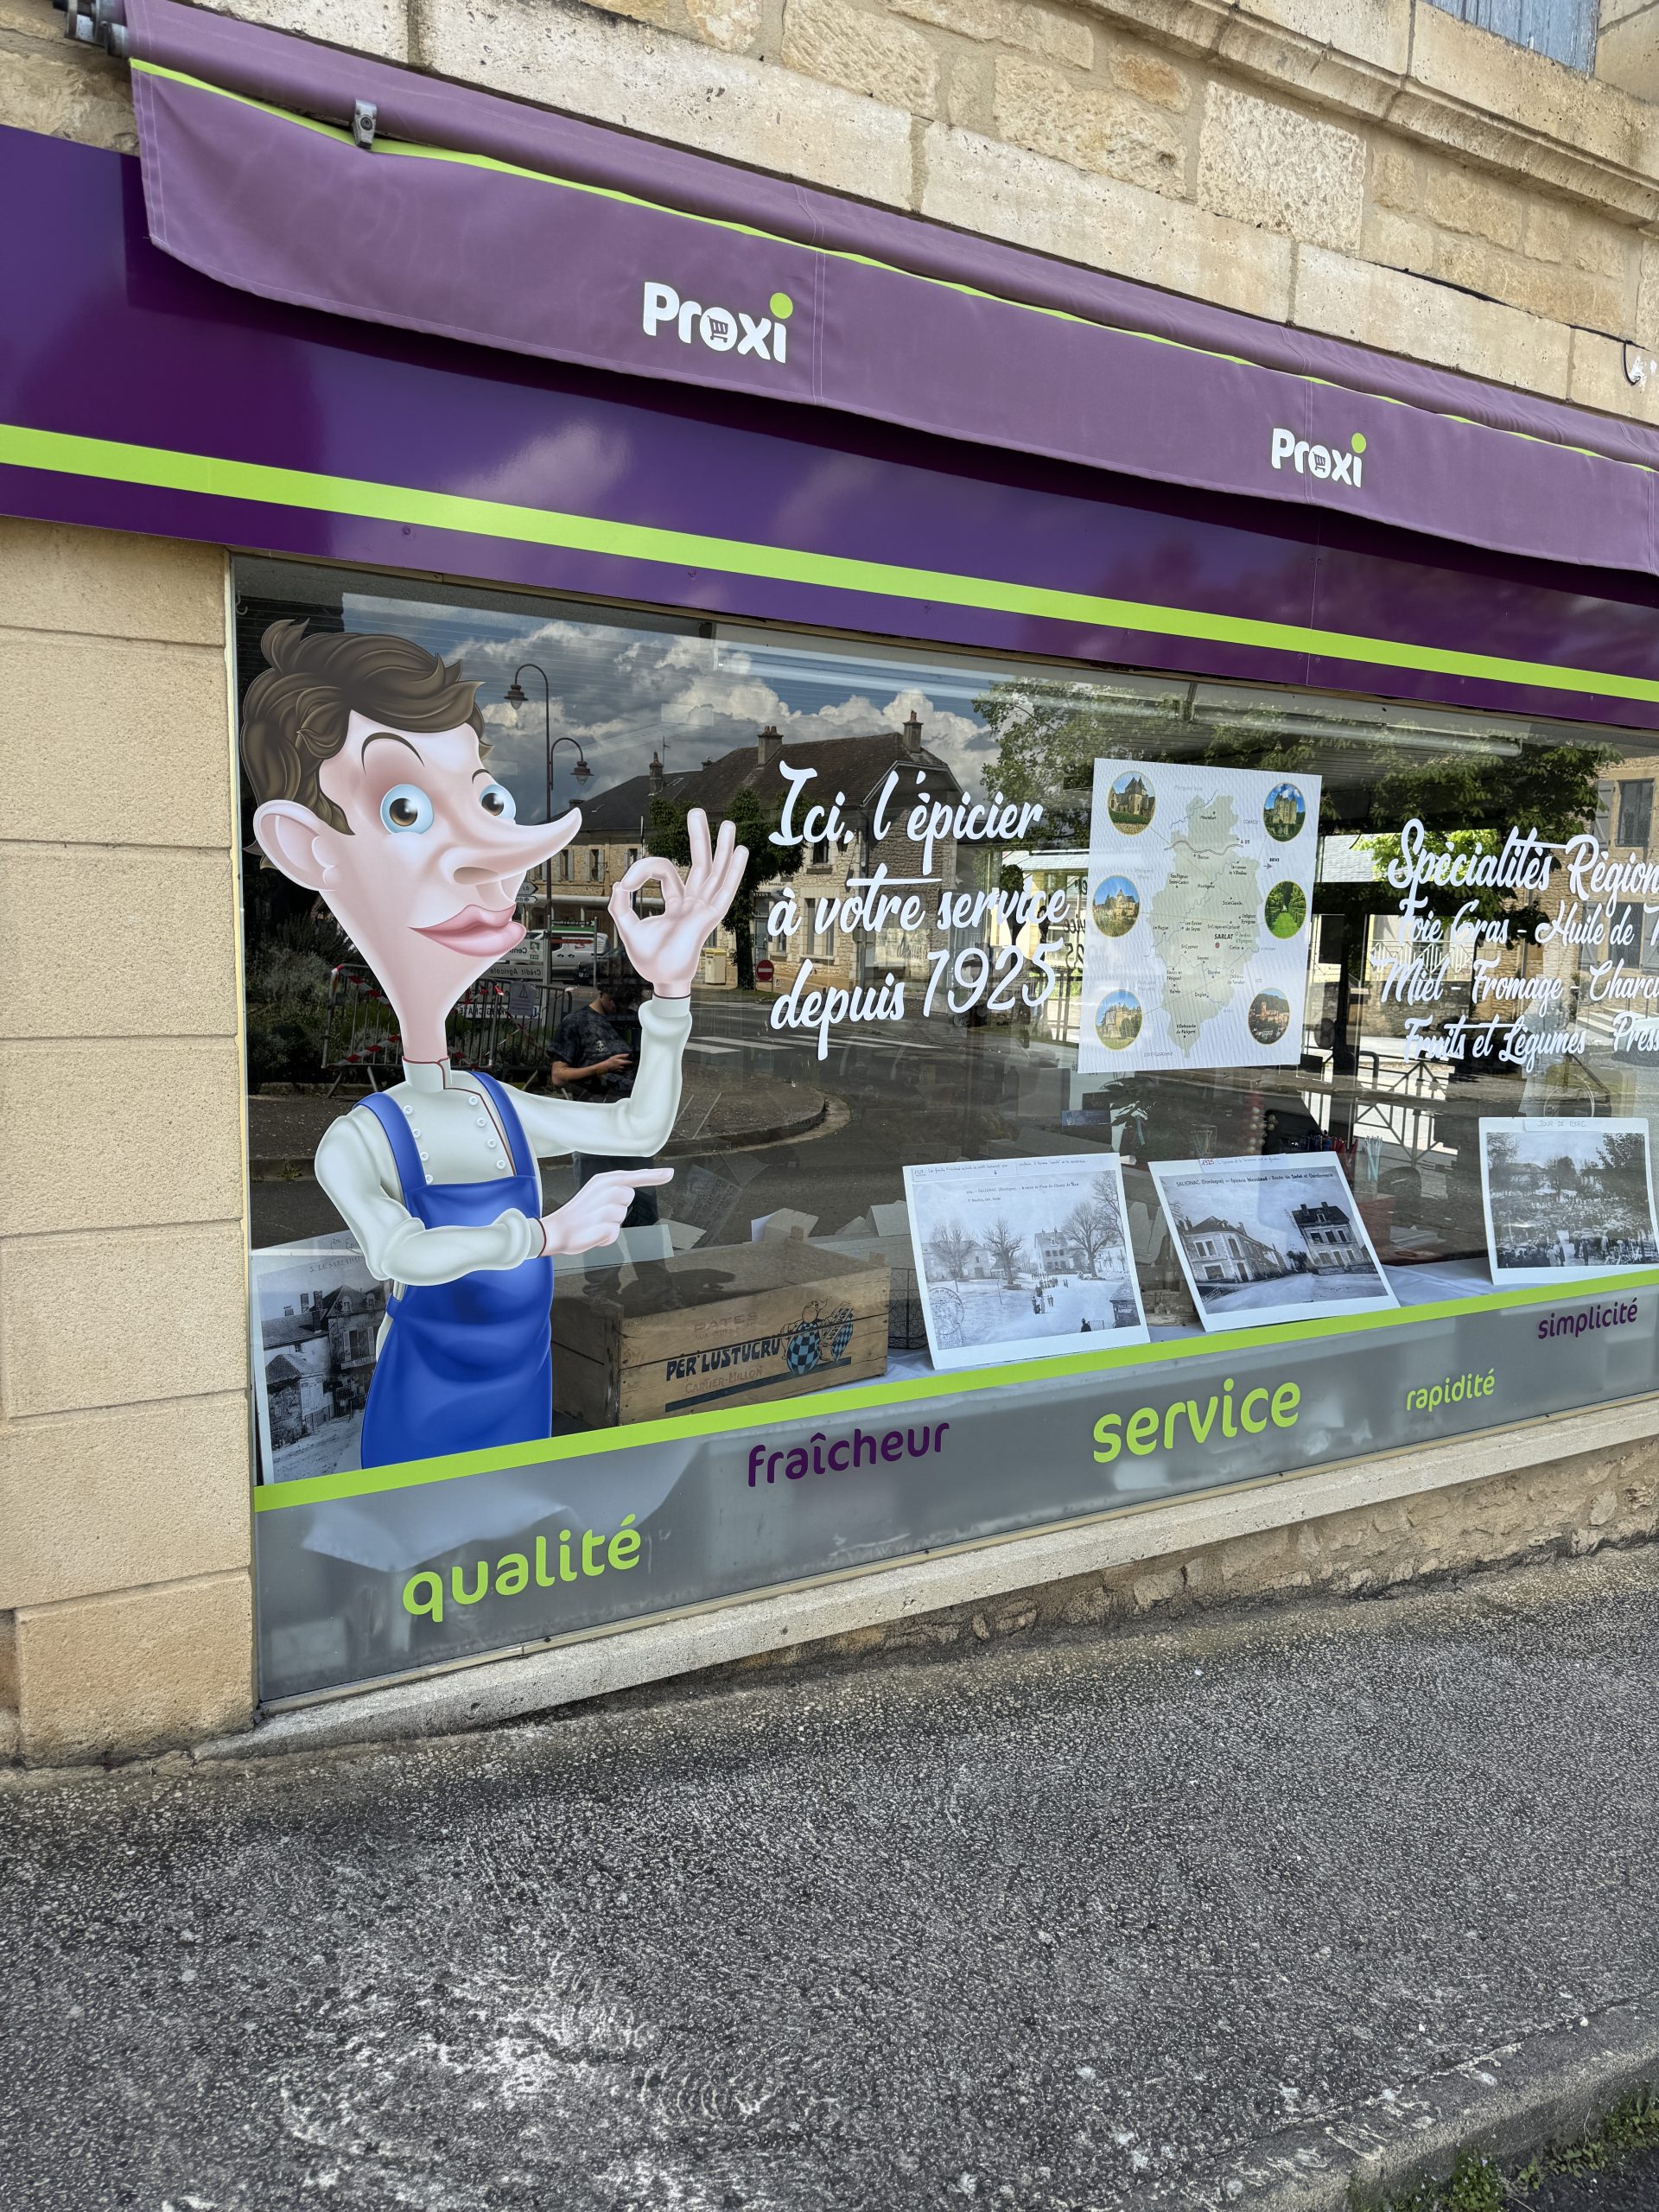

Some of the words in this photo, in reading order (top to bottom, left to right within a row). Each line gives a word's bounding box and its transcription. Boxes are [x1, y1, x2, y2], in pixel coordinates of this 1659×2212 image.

[643, 282, 793, 364] Proxi
[1272, 428, 1367, 488] Proxi
[768, 760, 854, 845] Ici,
[767, 887, 802, 936] à
[815, 863, 943, 935] votre
[937, 878, 1071, 931] service
[1398, 896, 1443, 945] Foie
[1451, 899, 1510, 945] Gras
[1535, 899, 1605, 945] Huile
[1610, 905, 1635, 945] de
[770, 959, 905, 1061] depuis
[924, 938, 1064, 1017] 1925
[1370, 956, 1451, 1006] Miel
[1471, 957, 1564, 1017] Fromage
[1404, 1014, 1466, 1064] Fruits
[1471, 1014, 1499, 1058] et
[1498, 1014, 1586, 1073] Légumes
[1538, 1297, 1638, 1339] simplicité
[1093, 1378, 1300, 1463] service
[1406, 1368, 1496, 1411] rapidité
[748, 1422, 950, 1488] fraîcheur
[403, 1514, 641, 1622] qualité
